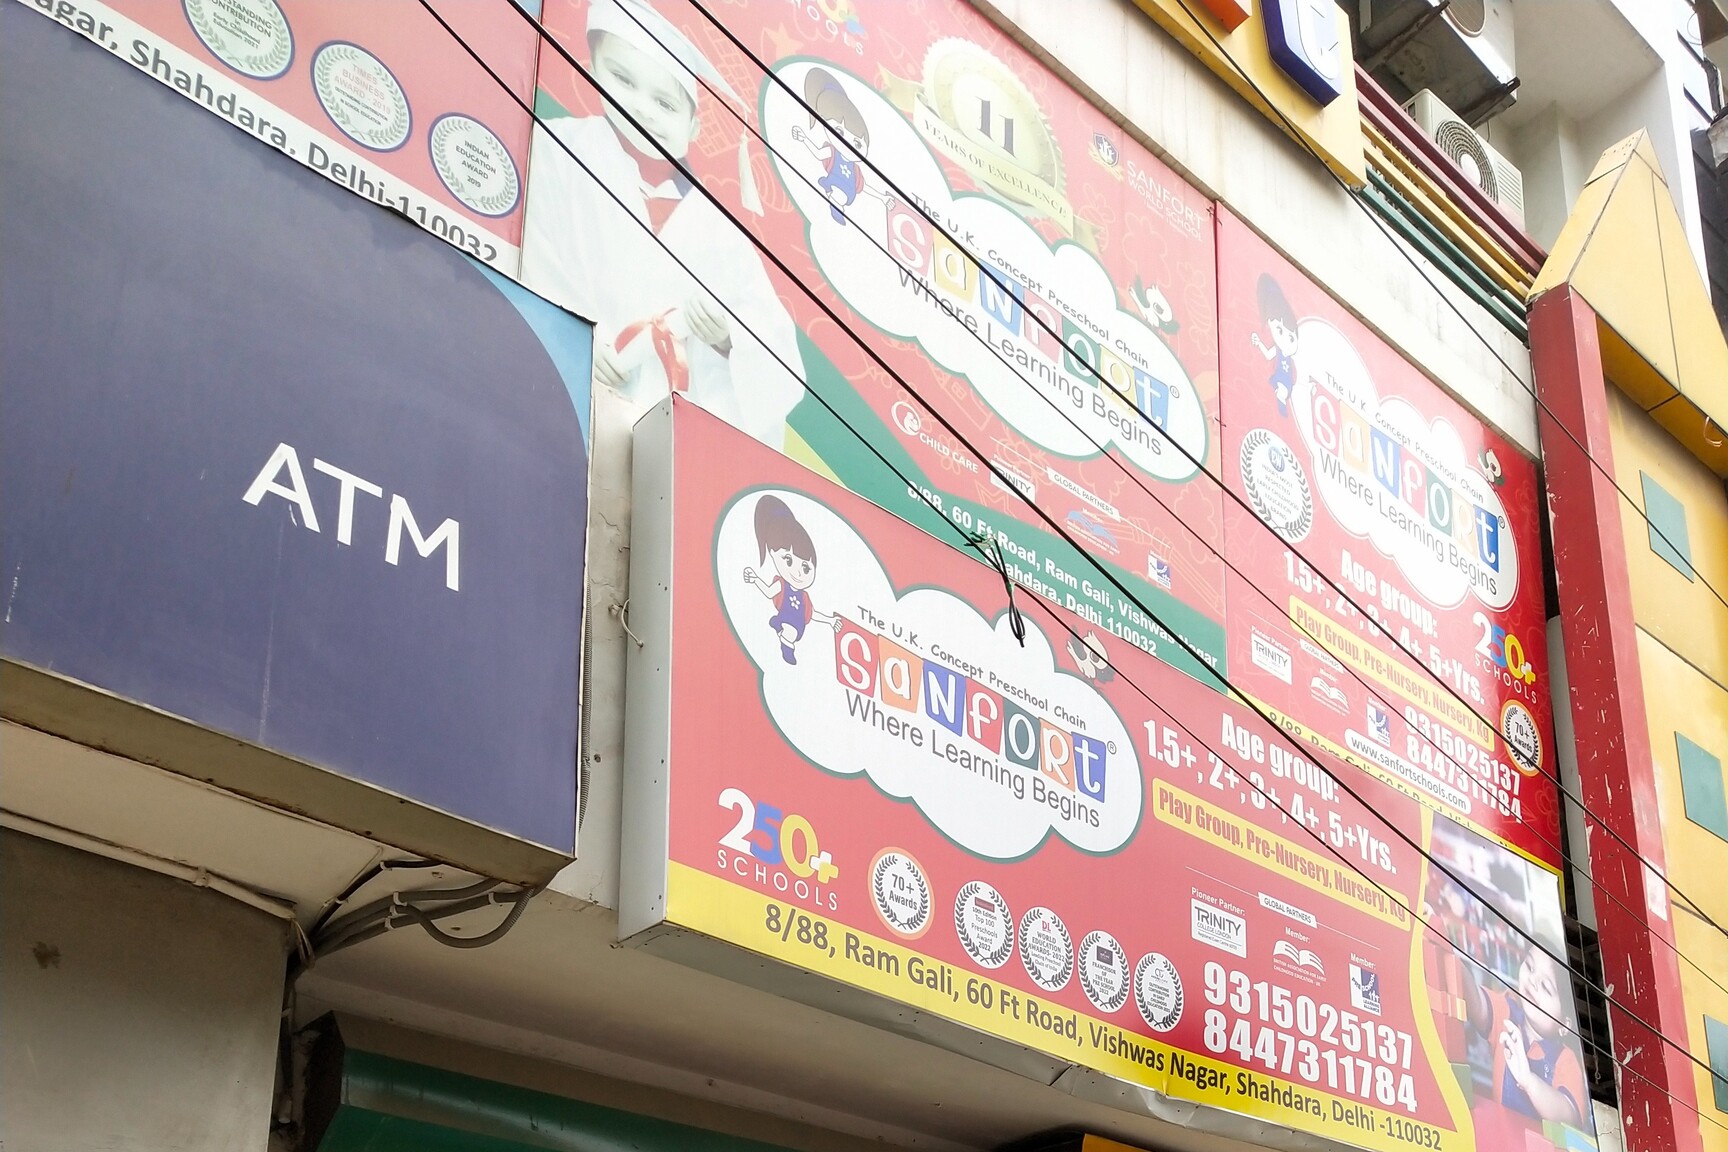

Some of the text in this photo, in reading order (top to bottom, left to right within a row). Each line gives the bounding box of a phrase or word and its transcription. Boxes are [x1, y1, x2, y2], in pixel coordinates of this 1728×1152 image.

[334, 75, 366, 100] AWARD
[342, 70, 385, 100] BUSINESS
[352, 64, 378, 85] TIMES
[130, 39, 296, 154] Shahdara,
[455, 145, 497, 174] EDUCATION
[461, 160, 489, 180] AWARD
[464, 140, 490, 160] INDIAN
[924, 119, 1067, 217] YEARS OF EXCELLENCE
[467, 176, 481, 188] 2019
[1127, 160, 1203, 229] SANFORT
[1128, 176, 1164, 209] WORLD
[1166, 207, 1202, 241] SCHOOL
[912, 192, 1149, 369] The U.K. Concept Preschool Chain
[899, 265, 1162, 456] Where Learning Begins
[920, 432, 949, 456] CHILD
[952, 452, 979, 474] CARE
[1325, 371, 1484, 503] The Concept Preschool Chain
[1054, 474, 1081, 496] GLOBAL
[1082, 490, 1114, 515] PARTNERS
[242, 443, 460, 592] ATM
[1320, 448, 1374, 506] Where
[1379, 491, 1444, 563] Learning
[1449, 543, 1497, 596] Begins
[952, 506, 972, 529] 60
[998, 530, 1040, 571] Road,
[1045, 558, 1077, 589] Ram
[1082, 580, 1114, 612] Gali,
[1118, 599, 1175, 644] Vishwas
[1341, 548, 1438, 640] Age group:
[985, 547, 1061, 607] Sahdara,
[1107, 618, 1157, 656] 110032
[857, 605, 1087, 731] The U.K. Concept Preschool Chain
[1253, 639, 1288, 667] TRINITY
[1473, 611, 1536, 685] 250+
[1296, 605, 1322, 639] Play
[1324, 626, 1362, 664] Group,
[1364, 648, 1431, 706] Pre-Nursery,
[1432, 697, 1475, 734] Nursery,
[1476, 720, 1489, 743] Kg
[1475, 653, 1537, 704] SCHOOLS
[1405, 705, 1520, 795] 9315025137
[1514, 721, 1530, 740] 70+
[1514, 735, 1533, 753] Awards
[846, 688, 1100, 828] Where Learning Begins
[1222, 713, 1265, 763] Age
[1269, 743, 1341, 803] group:
[1351, 736, 1467, 811] www.sanfortschools.com
[1407, 735, 1522, 824] 8447311784
[717, 787, 839, 884] 250+
[1159, 788, 1192, 824] Play
[1195, 805, 1244, 848] Group,
[1246, 829, 1332, 890] Pre-Nursery,
[1335, 872, 1389, 916] Nursery,
[1328, 811, 1397, 874] 5+Yrs.
[717, 849, 838, 911] SCHOOLS
[889, 890, 918, 911] Awards
[892, 873, 915, 895] 70+
[975, 913, 995, 928] Top 100
[1191, 886, 1246, 916] Pioneer Partner:
[1194, 905, 1241, 937] TRINITY
[1264, 897, 1311, 924] GLOBAL PARTNERS
[971, 922, 998, 939] Preschools
[976, 932, 993, 945] Award
[1032, 936, 1062, 953] EDUCATION
[1037, 931, 1057, 944] WORLD
[1041, 920, 1052, 932] DL
[1197, 922, 1232, 940] COLLEGE LONDON
[1285, 927, 1311, 944] Member:
[978, 942, 991, 952] 2022
[1052, 951, 1065, 962] 2022
[1350, 953, 1376, 970] Member:
[1100, 982, 1116, 992] SCHOOL
[1103, 977, 1114, 986] YEAR
[765, 904, 836, 958] 8/88,
[845, 932, 900, 977] Ram
[908, 956, 959, 1002] Gali,
[967, 978, 993, 1009] 60
[1000, 990, 1020, 1020] Ft
[1026, 999, 1083, 1046] Road,
[1089, 1022, 1165, 1071] Vishwas
[1170, 1051, 1231, 1095] Nagar,
[1236, 1072, 1327, 1121] Shahdara,
[1332, 1100, 1375, 1132] Delhi
[1204, 961, 1412, 1070] 9315025137
[1203, 1009, 1417, 1112] 8447311784
